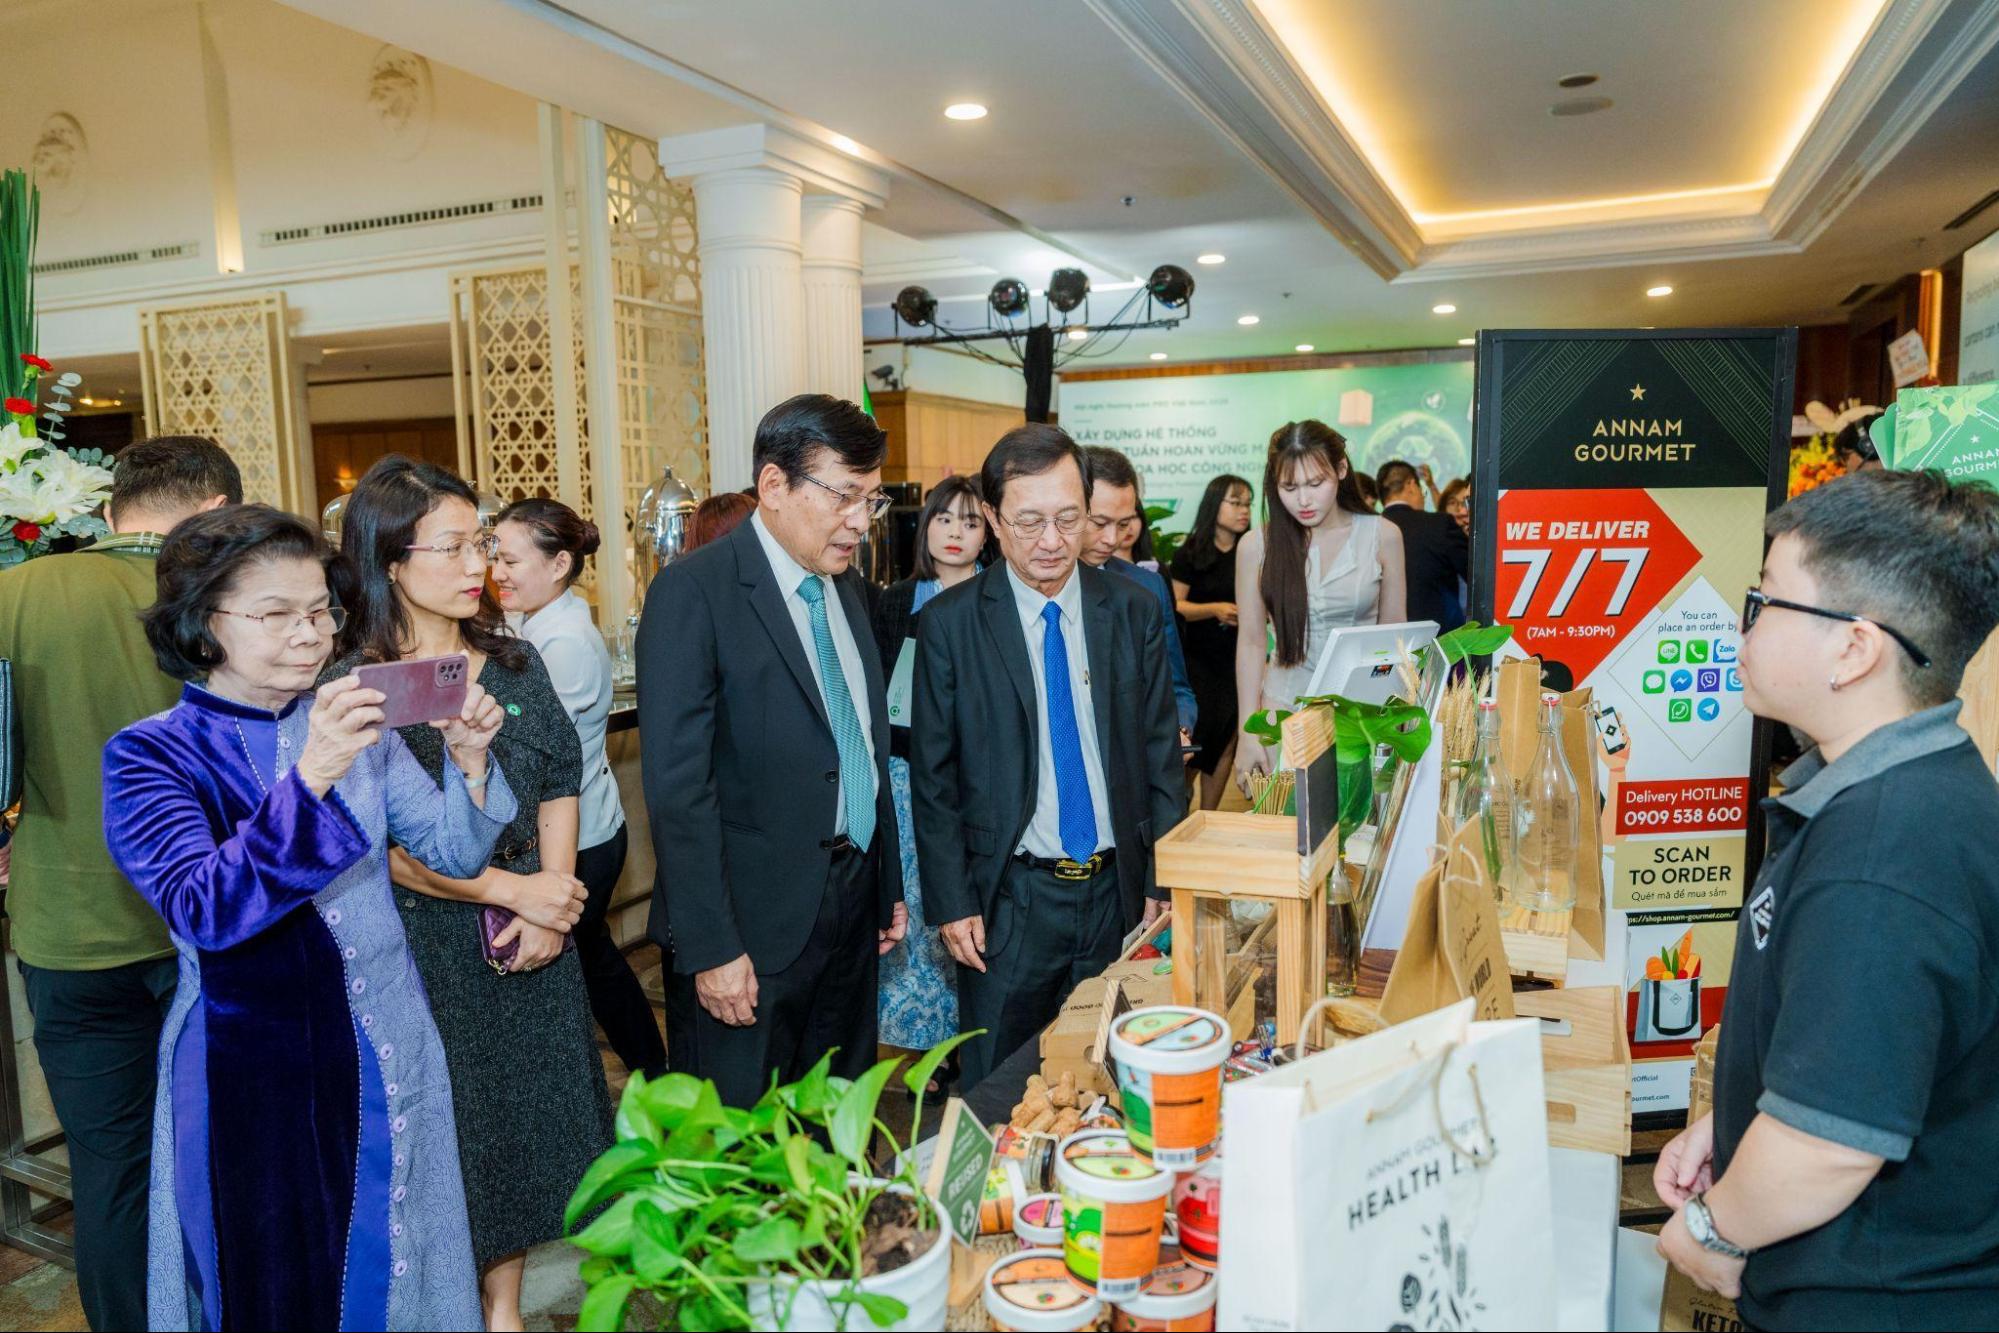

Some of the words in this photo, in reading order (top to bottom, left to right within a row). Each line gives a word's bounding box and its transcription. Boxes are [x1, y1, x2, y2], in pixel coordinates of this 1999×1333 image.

[1592, 418, 1682, 437] ANNAM
[1574, 444, 1697, 462] GOURMET
[1505, 521, 1543, 541] WE
[1548, 520, 1650, 540] DELIVER
[1502, 547, 1650, 619] 7/7
[1681, 610, 1698, 620] You
[1701, 611, 1718, 619] can
[1527, 626, 1556, 640] (7AM
[1567, 625, 1616, 639] 9:30PM)
[1657, 622, 1682, 634] place
[1685, 624, 1697, 632] an
[1700, 622, 1724, 631] order
[1626, 789, 1678, 805] Delivery
[1681, 786, 1743, 801] HOTLINE
[1624, 809, 1669, 826] 0909
[1672, 808, 1703, 824] 538
[1706, 806, 1742, 823] 600
[1653, 845, 1710, 863] SCAN
[1629, 869, 1656, 886] TO
[1661, 865, 1731, 884] ORDER
[1631, 890, 1654, 902] Quét
[1657, 891, 1671, 900] mã
[1673, 888, 1685, 899] để
[1687, 891, 1706, 899] mua
[1709, 886, 1727, 897] sắm
[1628, 910, 1735, 924] ps://shop.annam-gourmet.com/
[1632, 1094, 1670, 1102] ourmet.com
[1348, 1159, 1441, 1231] HEALTH
